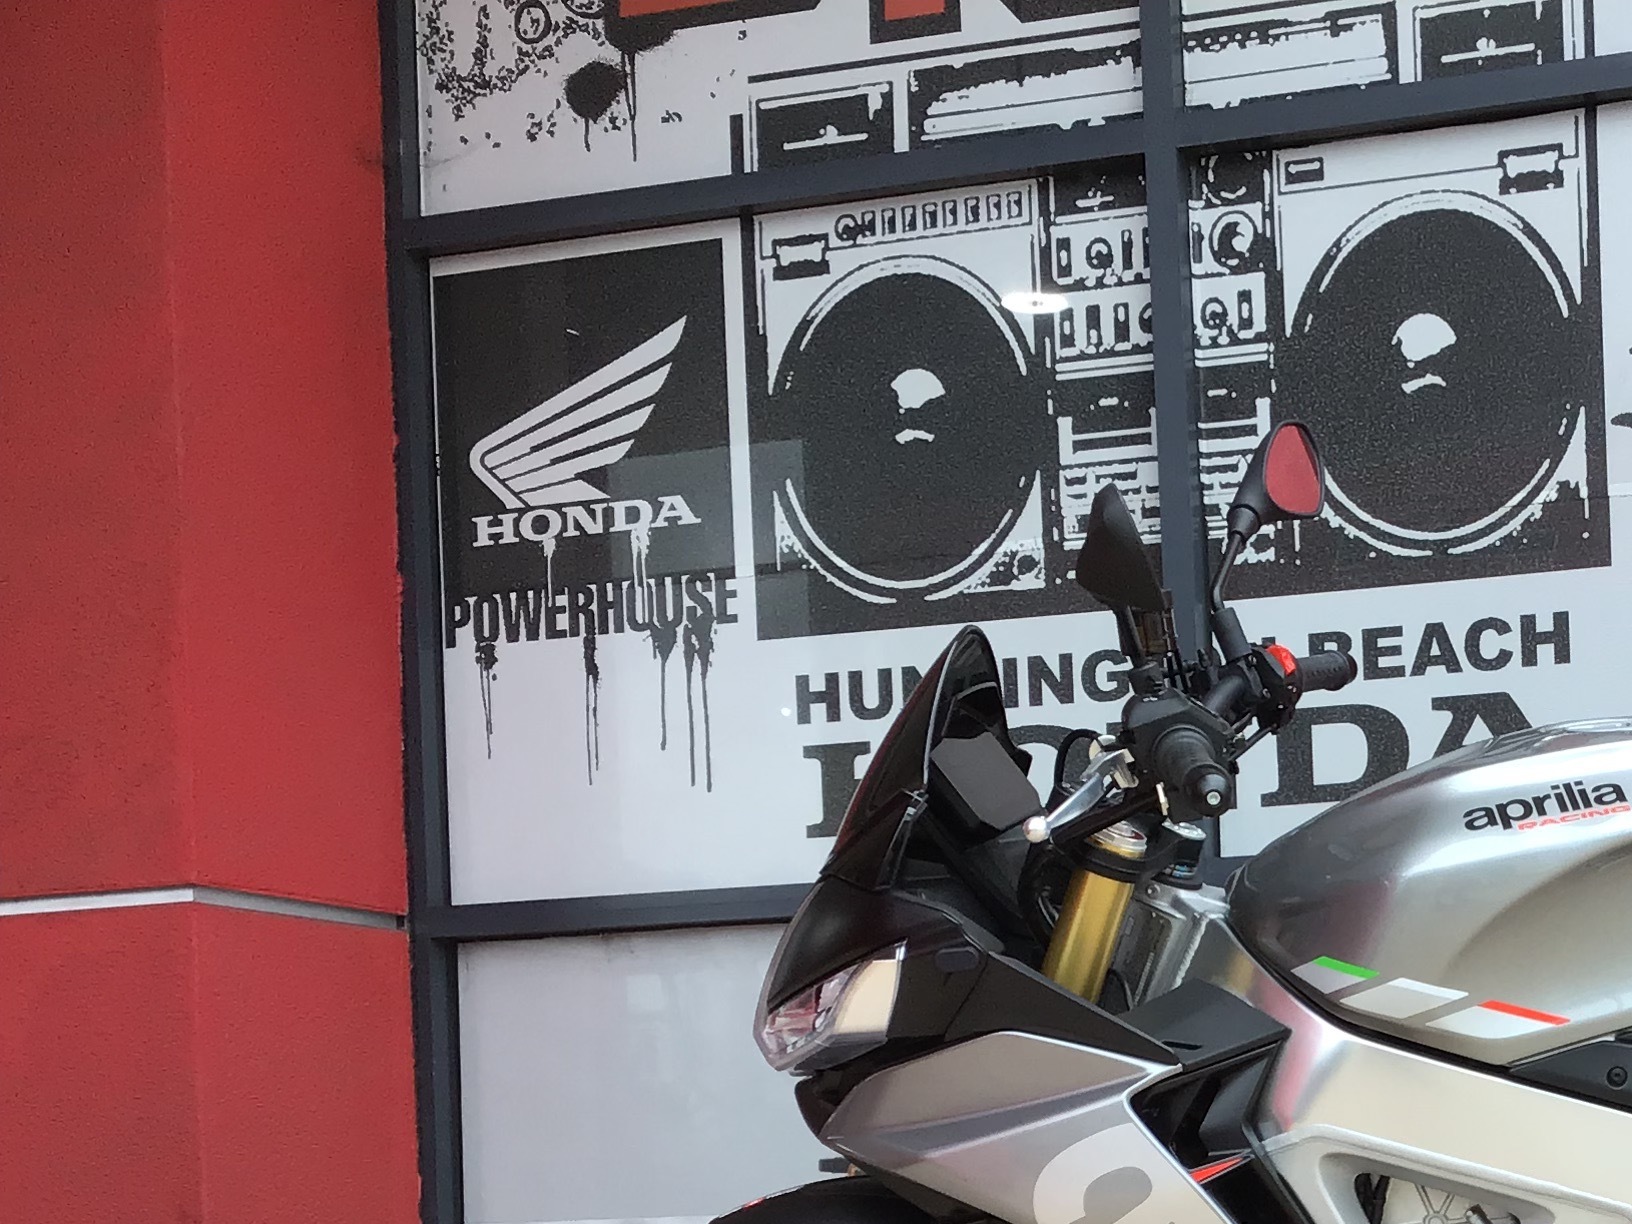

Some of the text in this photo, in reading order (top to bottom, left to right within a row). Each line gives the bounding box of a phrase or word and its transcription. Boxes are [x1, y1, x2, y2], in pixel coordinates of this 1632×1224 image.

[471, 494, 701, 548] HONDA
[445, 572, 738, 649] POWERHOUSE
[1462, 780, 1628, 831] aprilia
